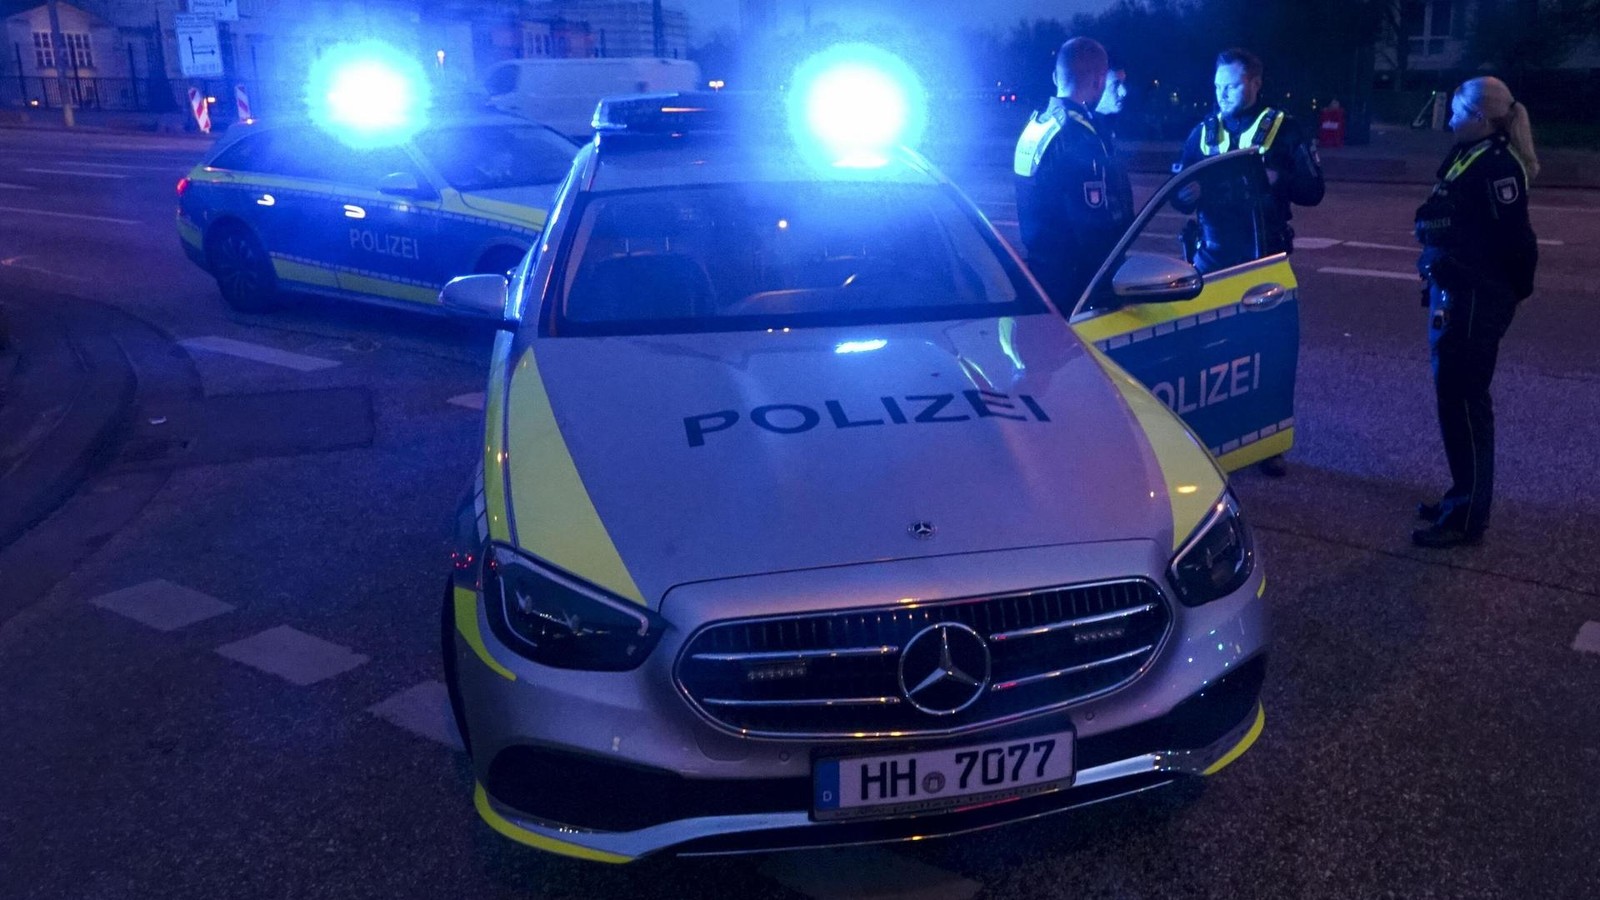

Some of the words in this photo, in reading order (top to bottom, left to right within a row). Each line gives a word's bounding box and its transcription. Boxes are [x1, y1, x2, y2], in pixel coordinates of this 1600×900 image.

[349, 228, 420, 260] POLIZEI
[1151, 352, 1261, 415] OLIZEI
[683, 389, 1052, 447] POLIZEI
[823, 791, 833, 802] D
[861, 759, 917, 801] HH
[955, 739, 1057, 789] 7077
